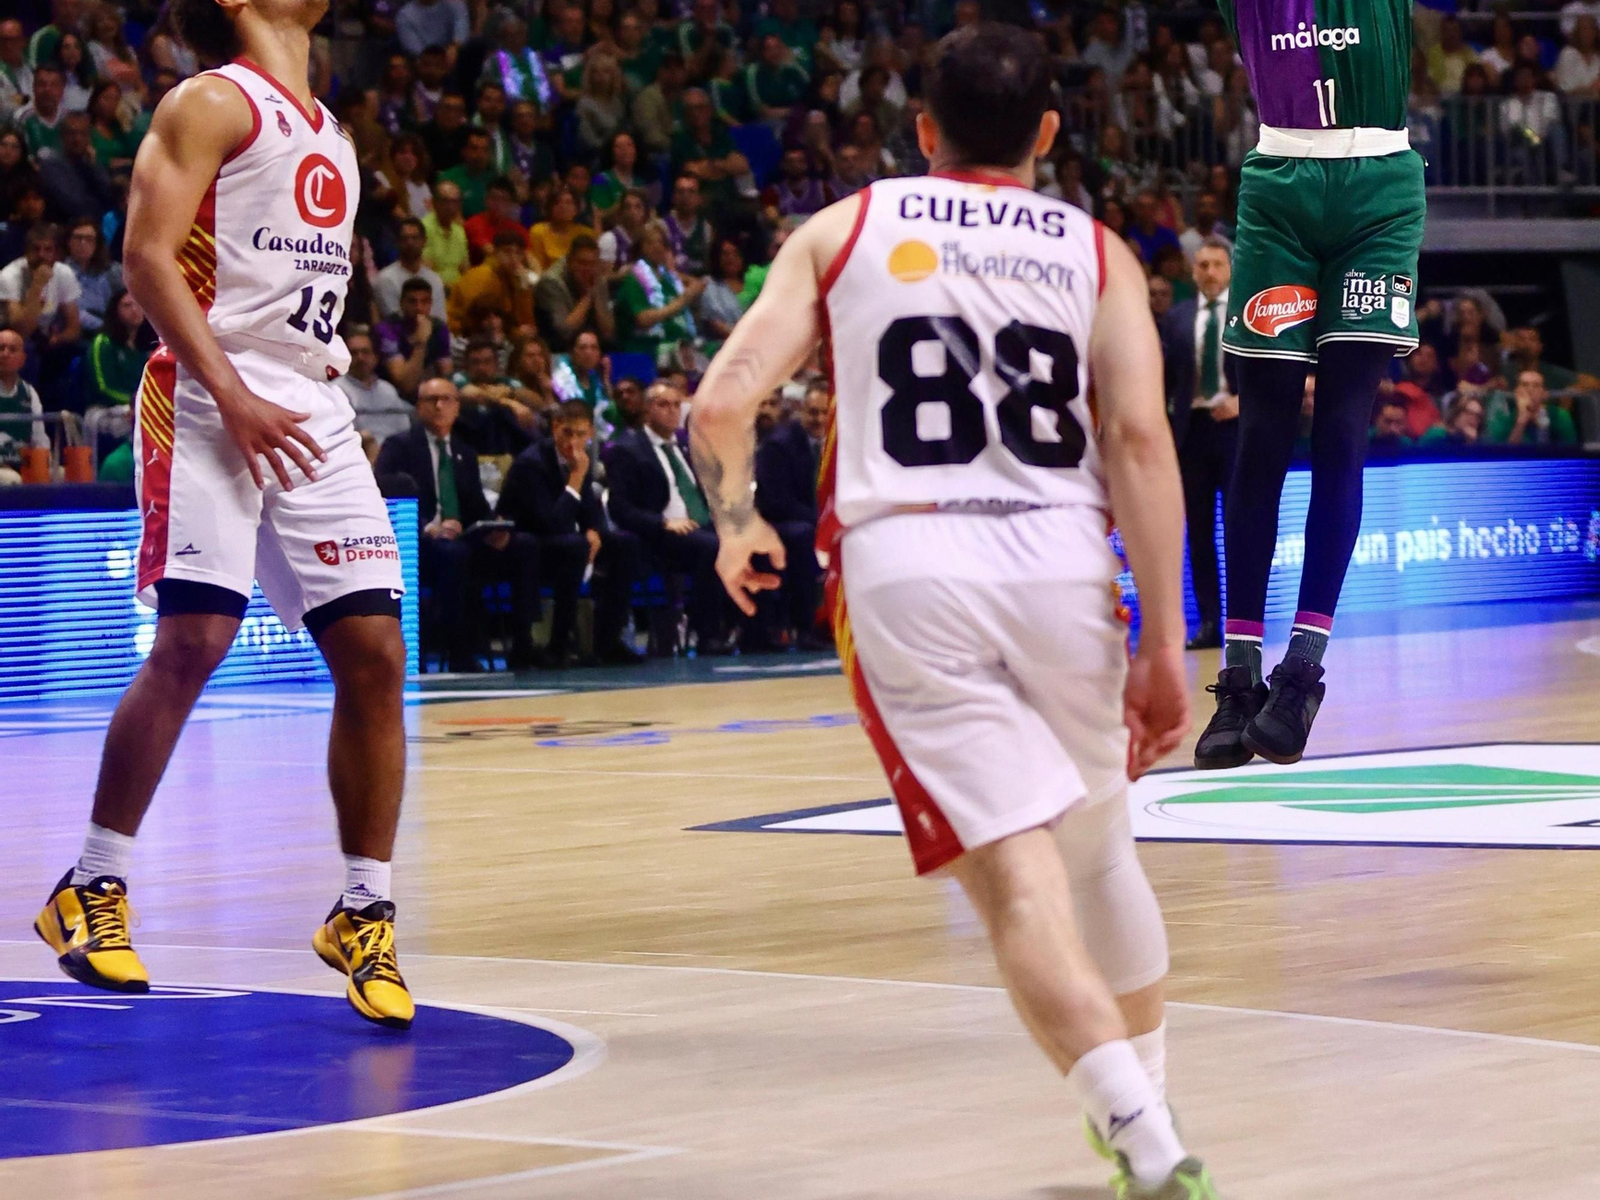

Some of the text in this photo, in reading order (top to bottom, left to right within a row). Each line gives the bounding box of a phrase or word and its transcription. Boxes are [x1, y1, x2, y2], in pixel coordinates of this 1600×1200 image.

[1312, 78, 1337, 127] 11
[898, 193, 1067, 239] CUEVAS
[252, 226, 349, 261] Casadem
[294, 258, 349, 277] ZARAGOZA
[1343, 274, 1387, 295] a má
[1344, 268, 1366, 279] sabor
[286, 285, 338, 346] 13
[1248, 289, 1318, 325] famadesa
[1341, 287, 1387, 315] laga
[877, 315, 1087, 468] 88
[342, 535, 396, 548] Zaragoza
[346, 549, 399, 563] DEPORTE
[1458, 518, 1541, 559] hecho
